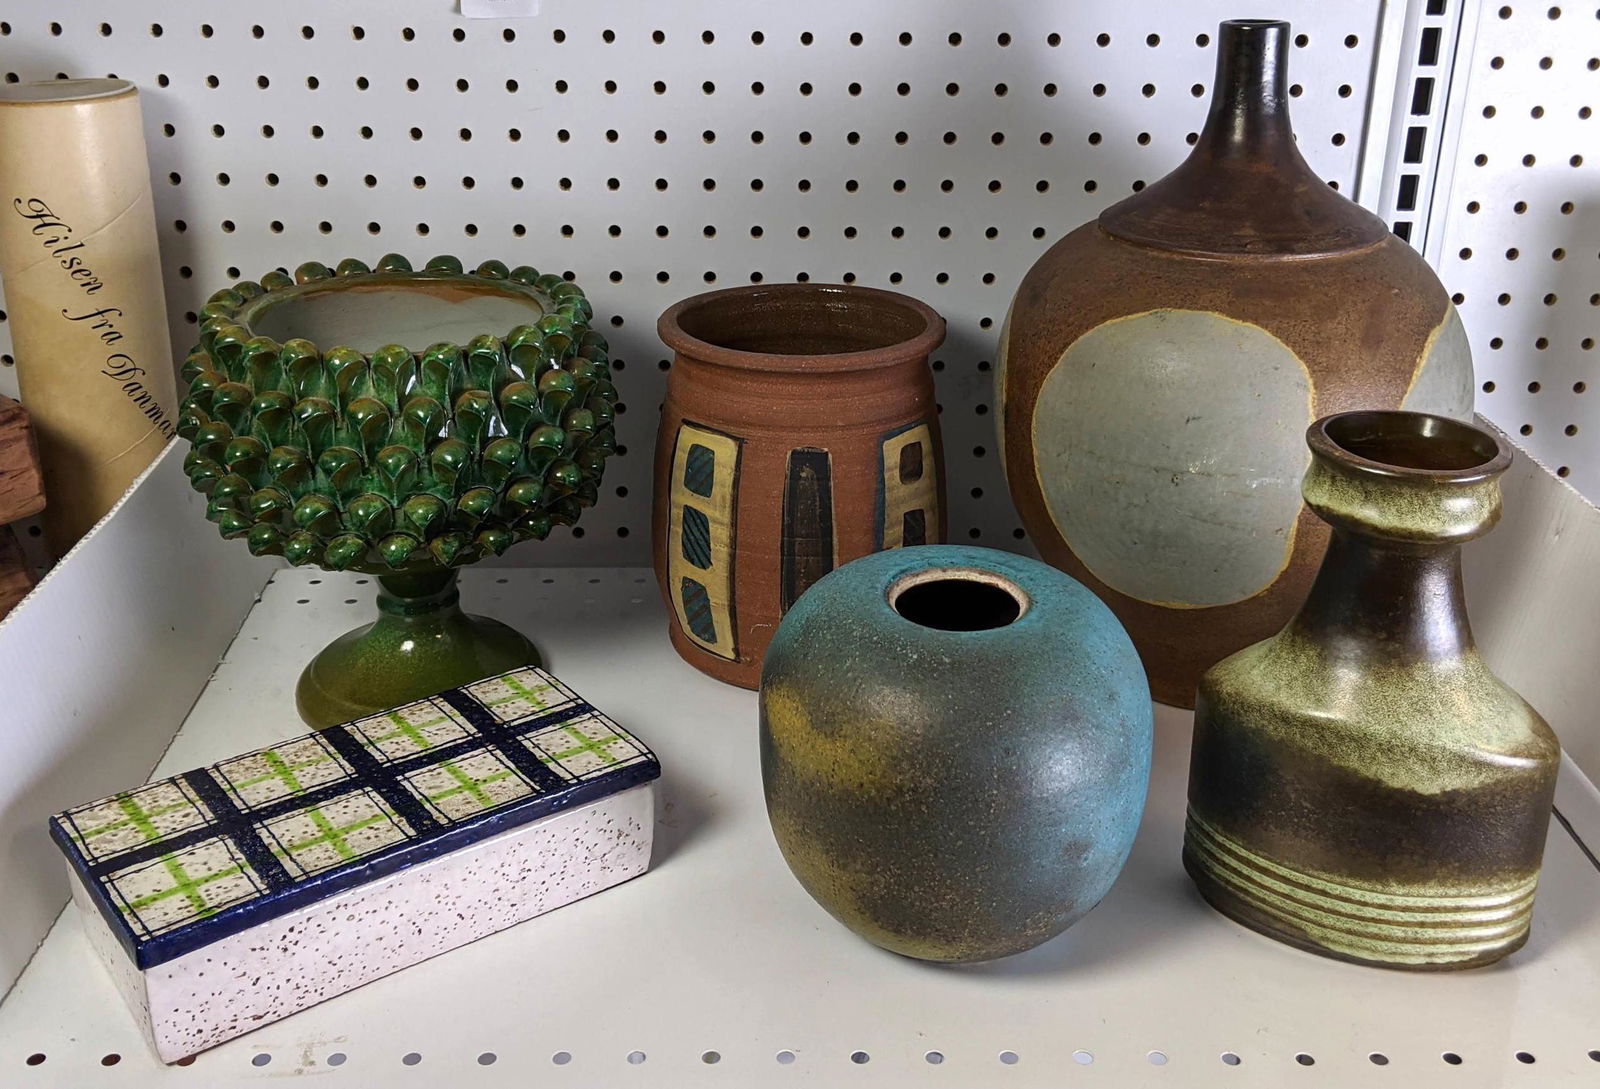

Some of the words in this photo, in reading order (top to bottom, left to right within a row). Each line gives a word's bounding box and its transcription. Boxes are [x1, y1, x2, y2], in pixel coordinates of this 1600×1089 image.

[13, 197, 105, 295] Hilsen
[61, 307, 124, 346] fra
[100, 353, 177, 440] Danmar
